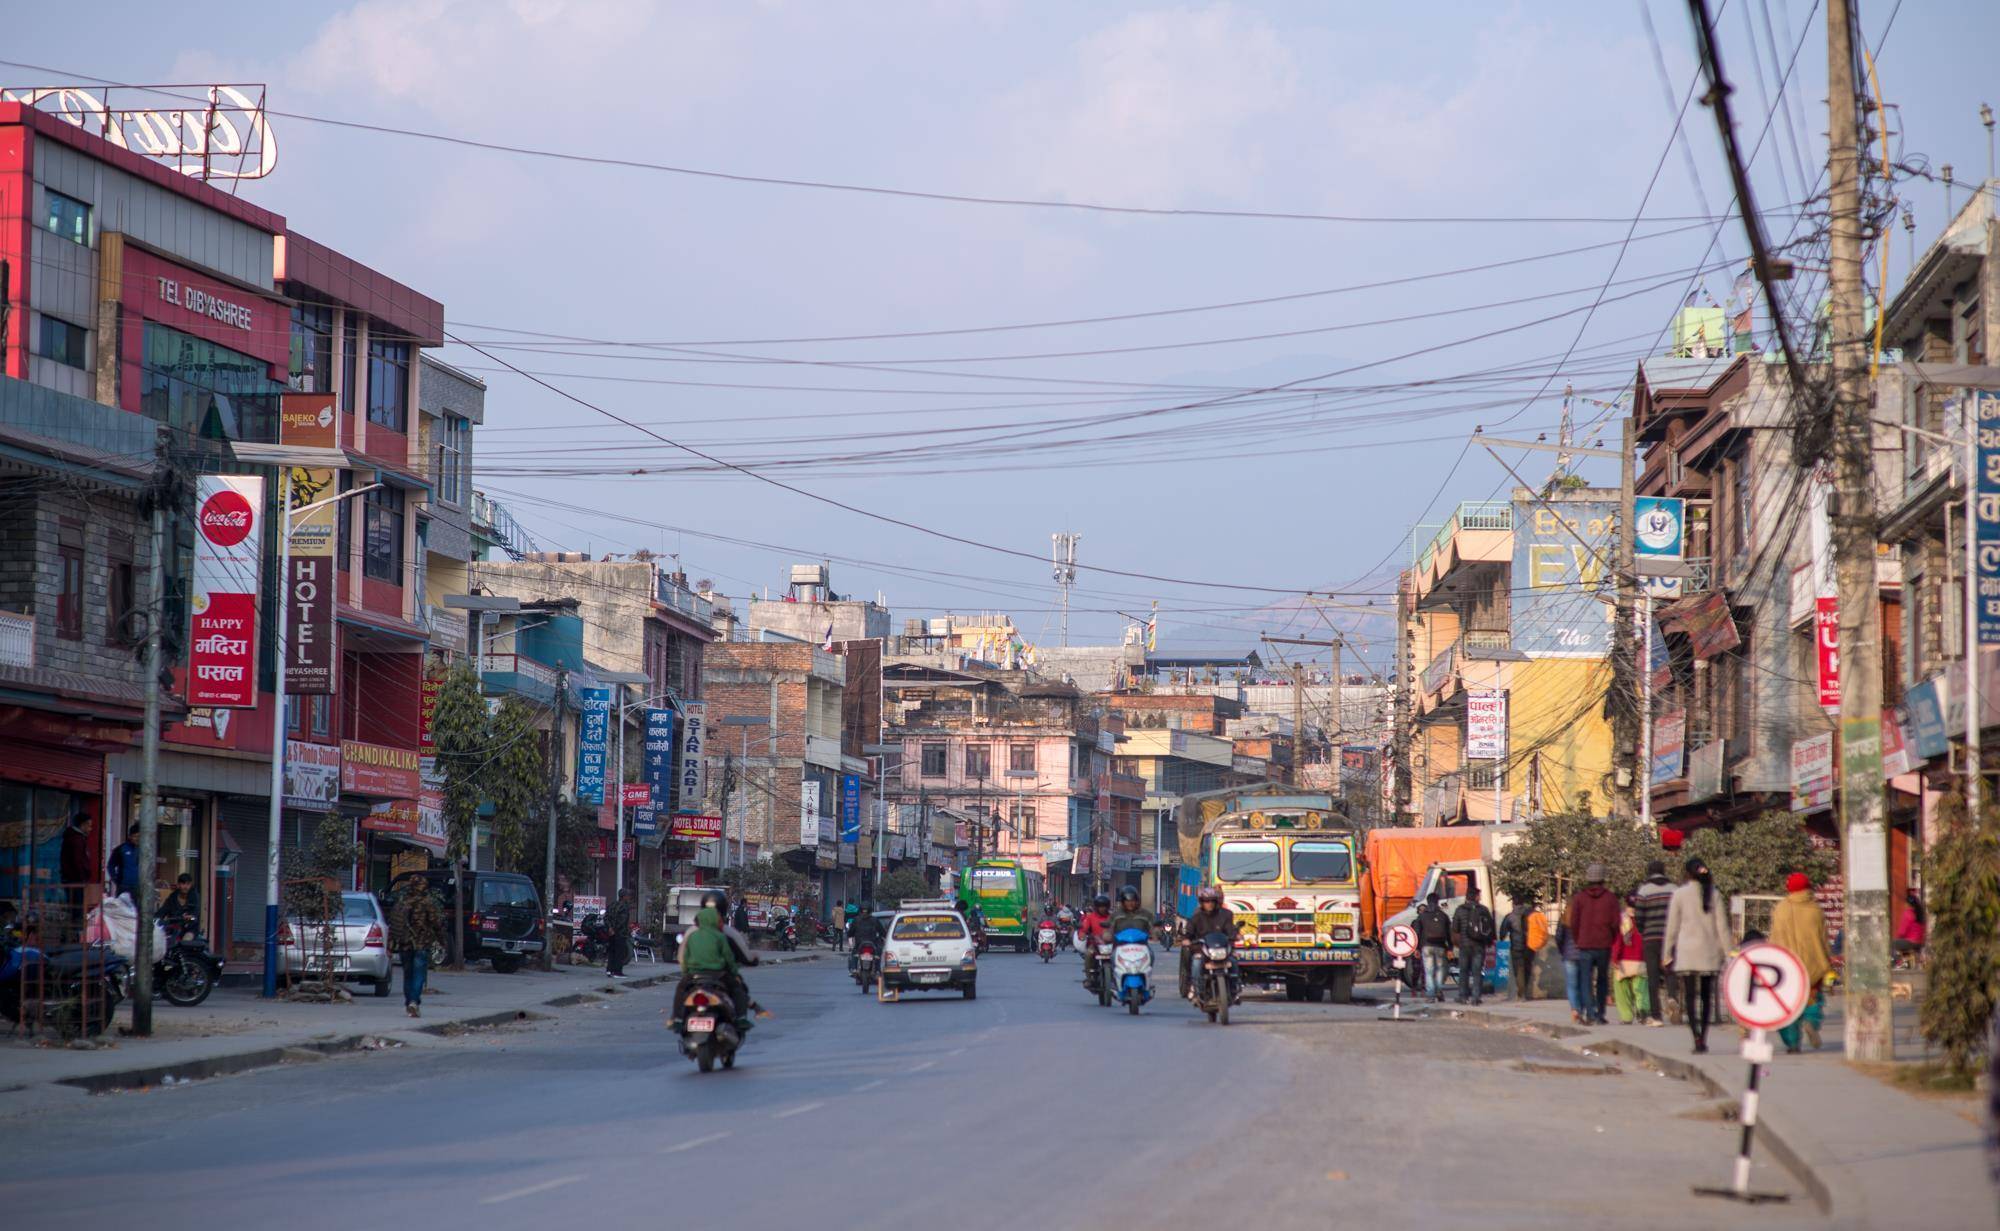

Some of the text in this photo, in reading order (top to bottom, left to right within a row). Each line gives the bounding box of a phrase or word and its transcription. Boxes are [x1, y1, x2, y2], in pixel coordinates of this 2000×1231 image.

[158, 277, 252, 331] TEL DIBYASHREE
[283, 413, 316, 428] BAJEKO
[296, 561, 317, 664] HOTEL
[201, 618, 243, 629] HAPPY
[195, 634, 248, 656] मदिरा
[197, 666, 244, 681] पसल
[584, 697, 608, 711] होटल
[686, 704, 704, 715] HOTEL
[299, 744, 318, 765] Photo
[343, 744, 418, 770] CHANDIKALIKA
[684, 718, 701, 797] STAR RABI
[628, 791, 648, 799] GME
[673, 817, 692, 829] HOTEL
[694, 818, 709, 830] STAR
[1236, 951, 1270, 961] PEED
[1305, 950, 1354, 962] CONTROL
[1746, 962, 1784, 1005] P
